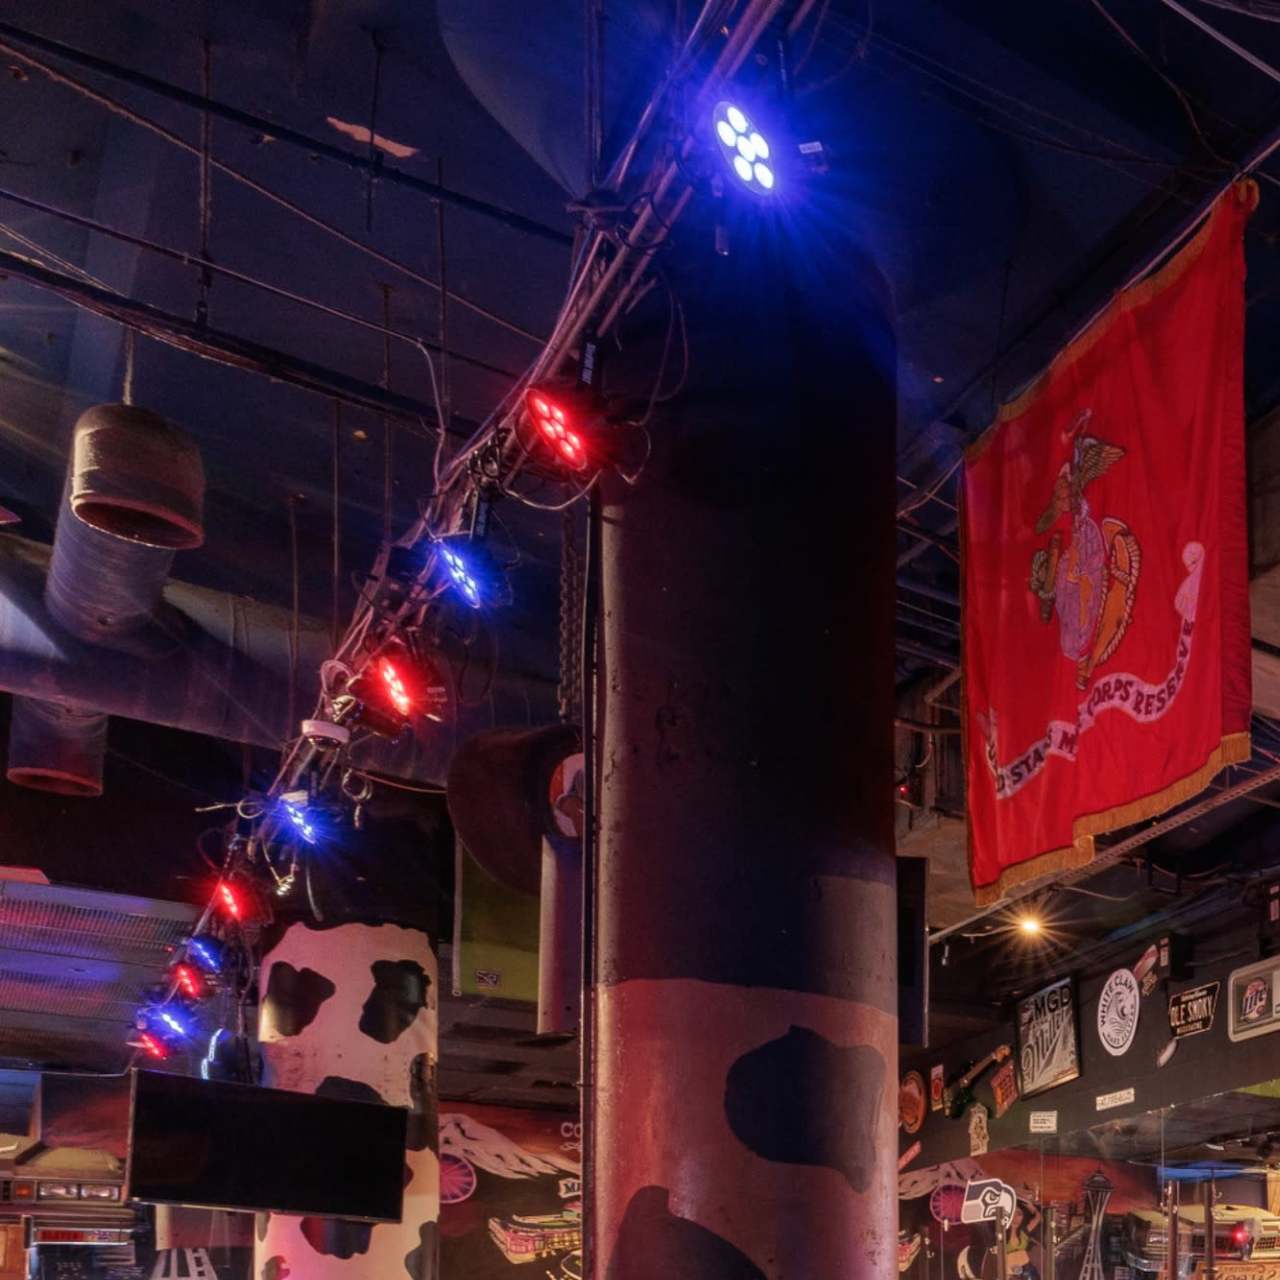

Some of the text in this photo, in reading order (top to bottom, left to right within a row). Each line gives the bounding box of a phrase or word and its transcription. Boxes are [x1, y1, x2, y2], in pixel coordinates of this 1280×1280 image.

[1033, 985, 1073, 1020] MGD
[1100, 974, 1135, 1027] WHITE CLAW
[1169, 1004, 1186, 1027] OLE
[1187, 994, 1214, 1022] SMOKY
